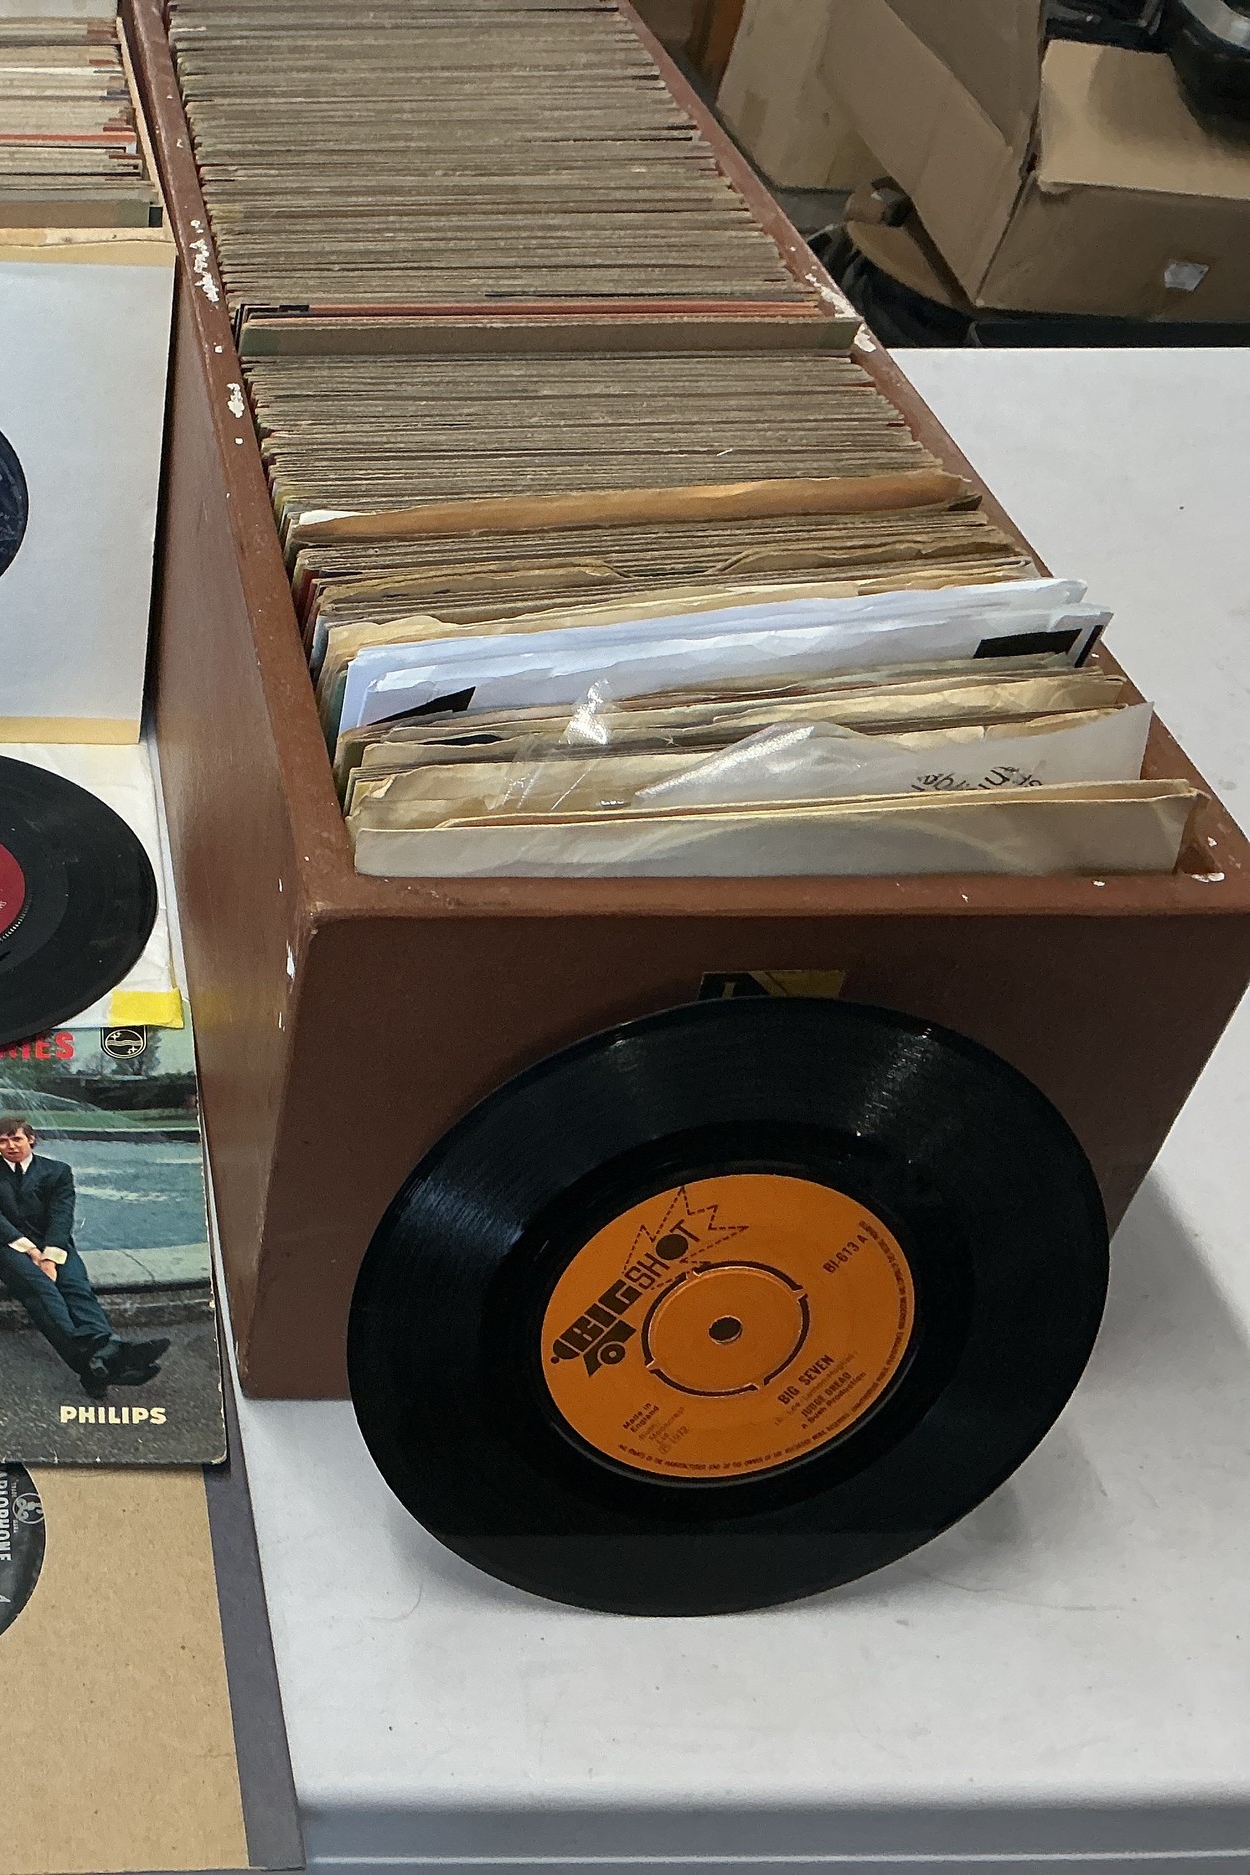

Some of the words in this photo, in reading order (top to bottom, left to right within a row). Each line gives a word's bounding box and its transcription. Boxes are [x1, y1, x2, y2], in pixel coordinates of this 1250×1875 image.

[856, 1233, 869, 1244] A
[777, 1385, 800, 1405] BIG
[797, 1354, 835, 1386] SEVEN
[824, 1371, 852, 1396] DREAD
[826, 1371, 866, 1407] Production
[60, 1405, 167, 1424] PHILIPS
[622, 1411, 643, 1429] Made
[643, 1402, 652, 1410] in
[630, 1404, 660, 1433] England
